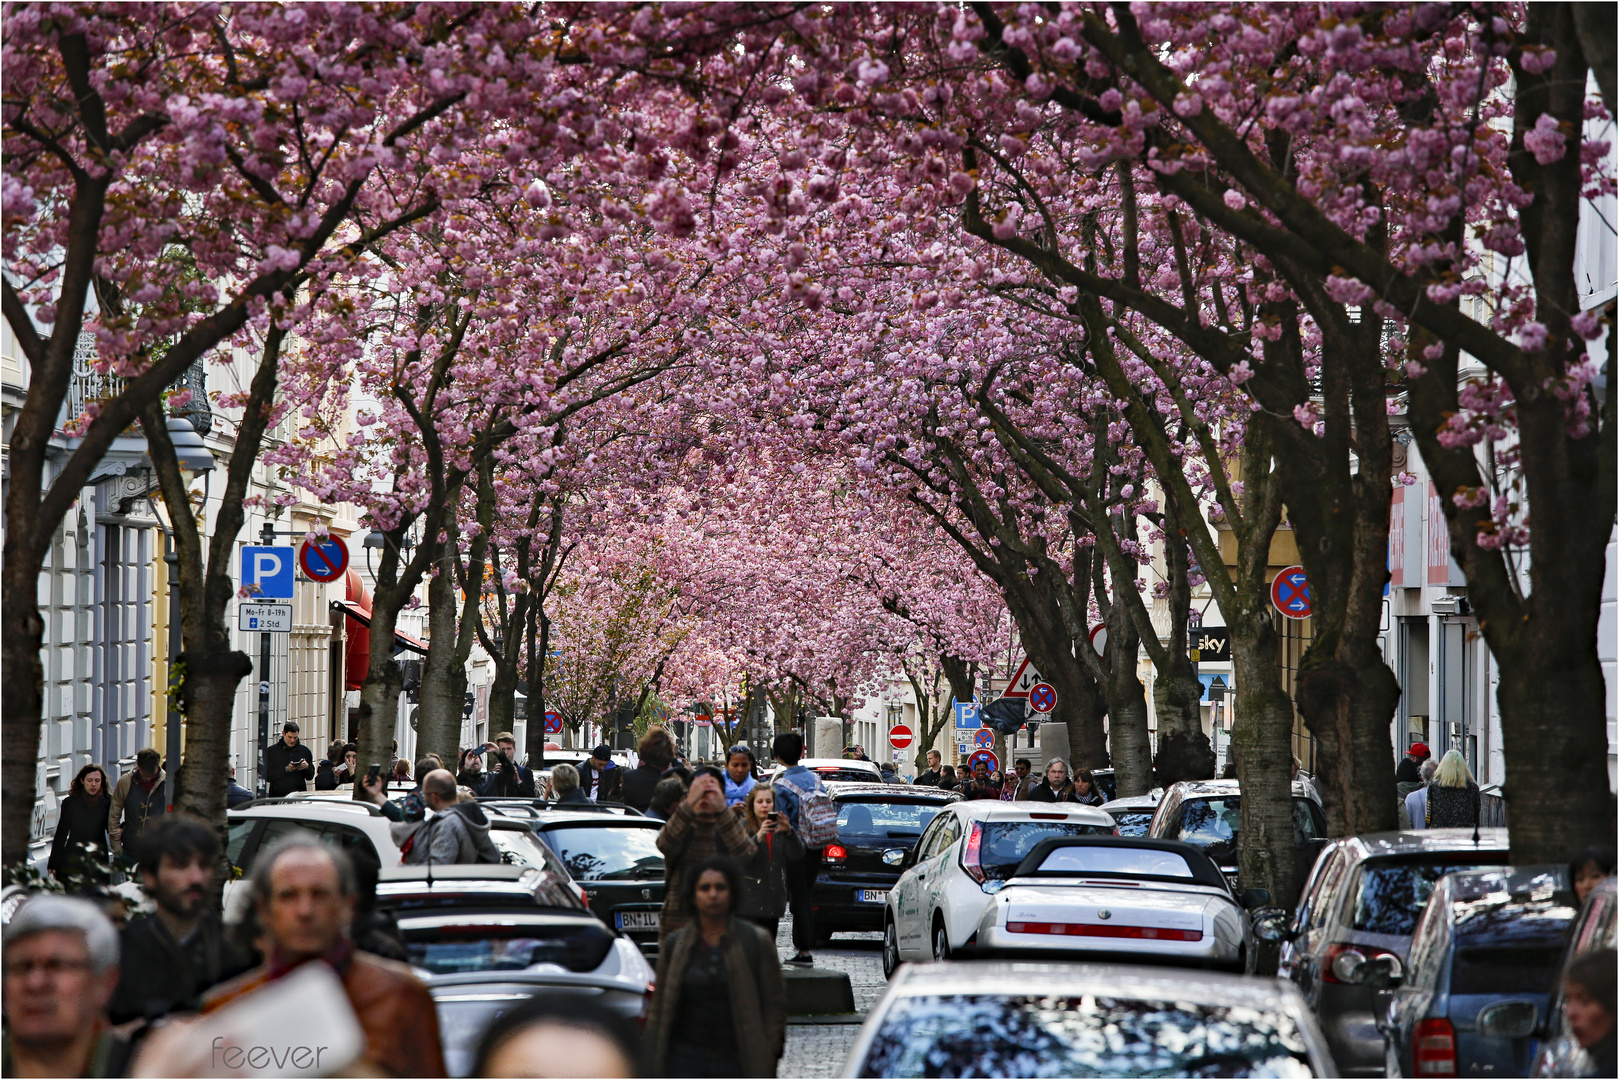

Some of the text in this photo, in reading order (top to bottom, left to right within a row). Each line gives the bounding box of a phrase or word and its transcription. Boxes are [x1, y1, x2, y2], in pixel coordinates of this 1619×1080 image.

[254, 553, 282, 591] P
[245, 608, 286, 617] Mo-Fr 8-19h
[260, 620, 265, 628] 2
[1198, 634, 1226, 654] sky
[961, 706, 976, 726] P
[863, 890, 877, 901] BN
[622, 913, 656, 927] BN IL
